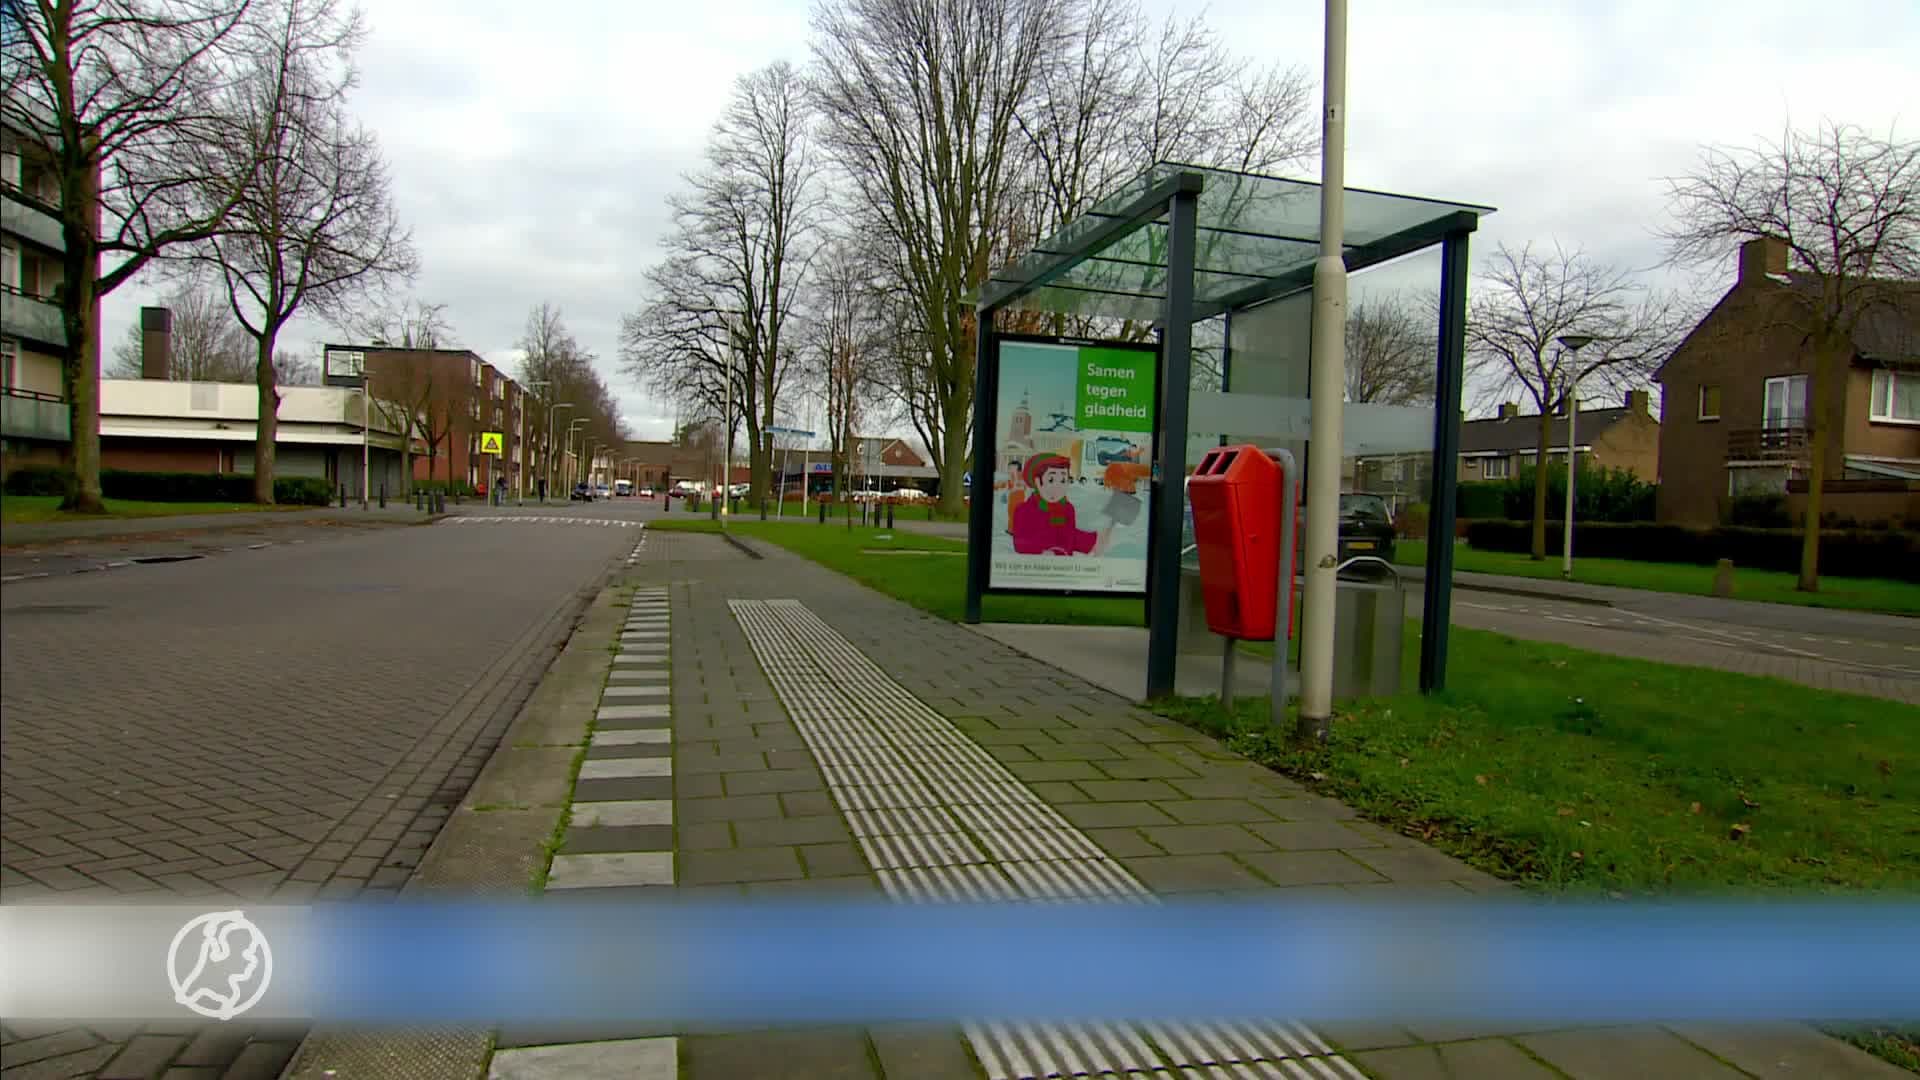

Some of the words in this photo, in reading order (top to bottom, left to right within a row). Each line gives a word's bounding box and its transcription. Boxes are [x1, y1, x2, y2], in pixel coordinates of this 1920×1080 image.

[1087, 362, 1136, 380] Samen
[1086, 383, 1128, 400] tegen
[1085, 402, 1147, 419] gladheid
